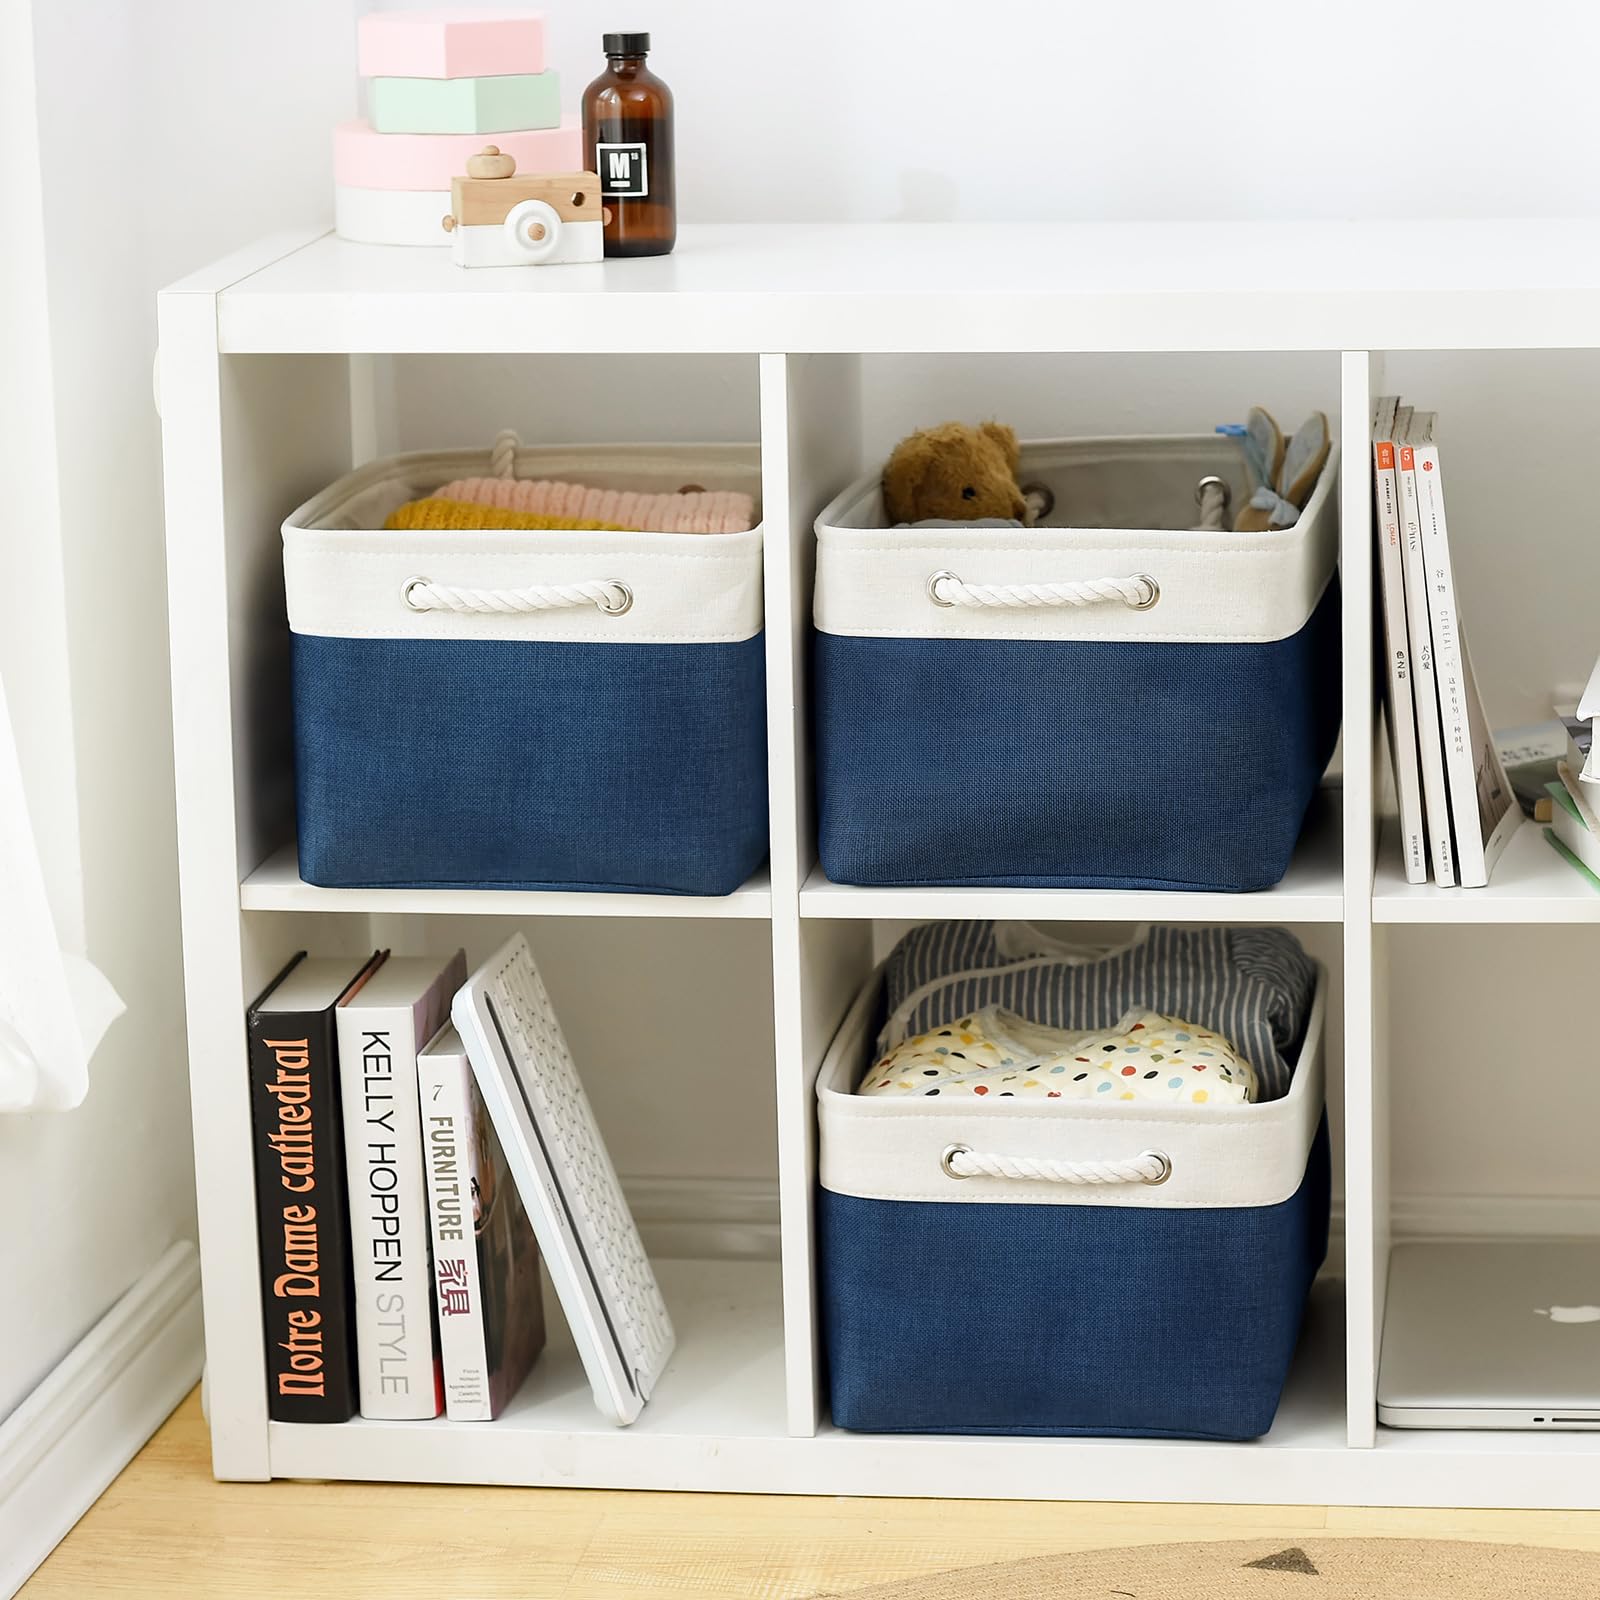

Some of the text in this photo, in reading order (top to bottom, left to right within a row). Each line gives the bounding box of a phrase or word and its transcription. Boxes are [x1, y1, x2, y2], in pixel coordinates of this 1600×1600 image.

[1403, 450, 1411, 461] 5
[1436, 569, 1446, 593] 谷物
[1440, 610, 1452, 650] CEREAL
[1396, 650, 1406, 679] 色之彩
[432, 1084, 444, 1102] 7
[429, 1116, 464, 1242] FURNITURE
[263, 1038, 325, 1397] Notre Dame cathedral
[361, 1031, 409, 1395] KELLY HOPPEN STYLE
[437, 1259, 471, 1317] 家具
